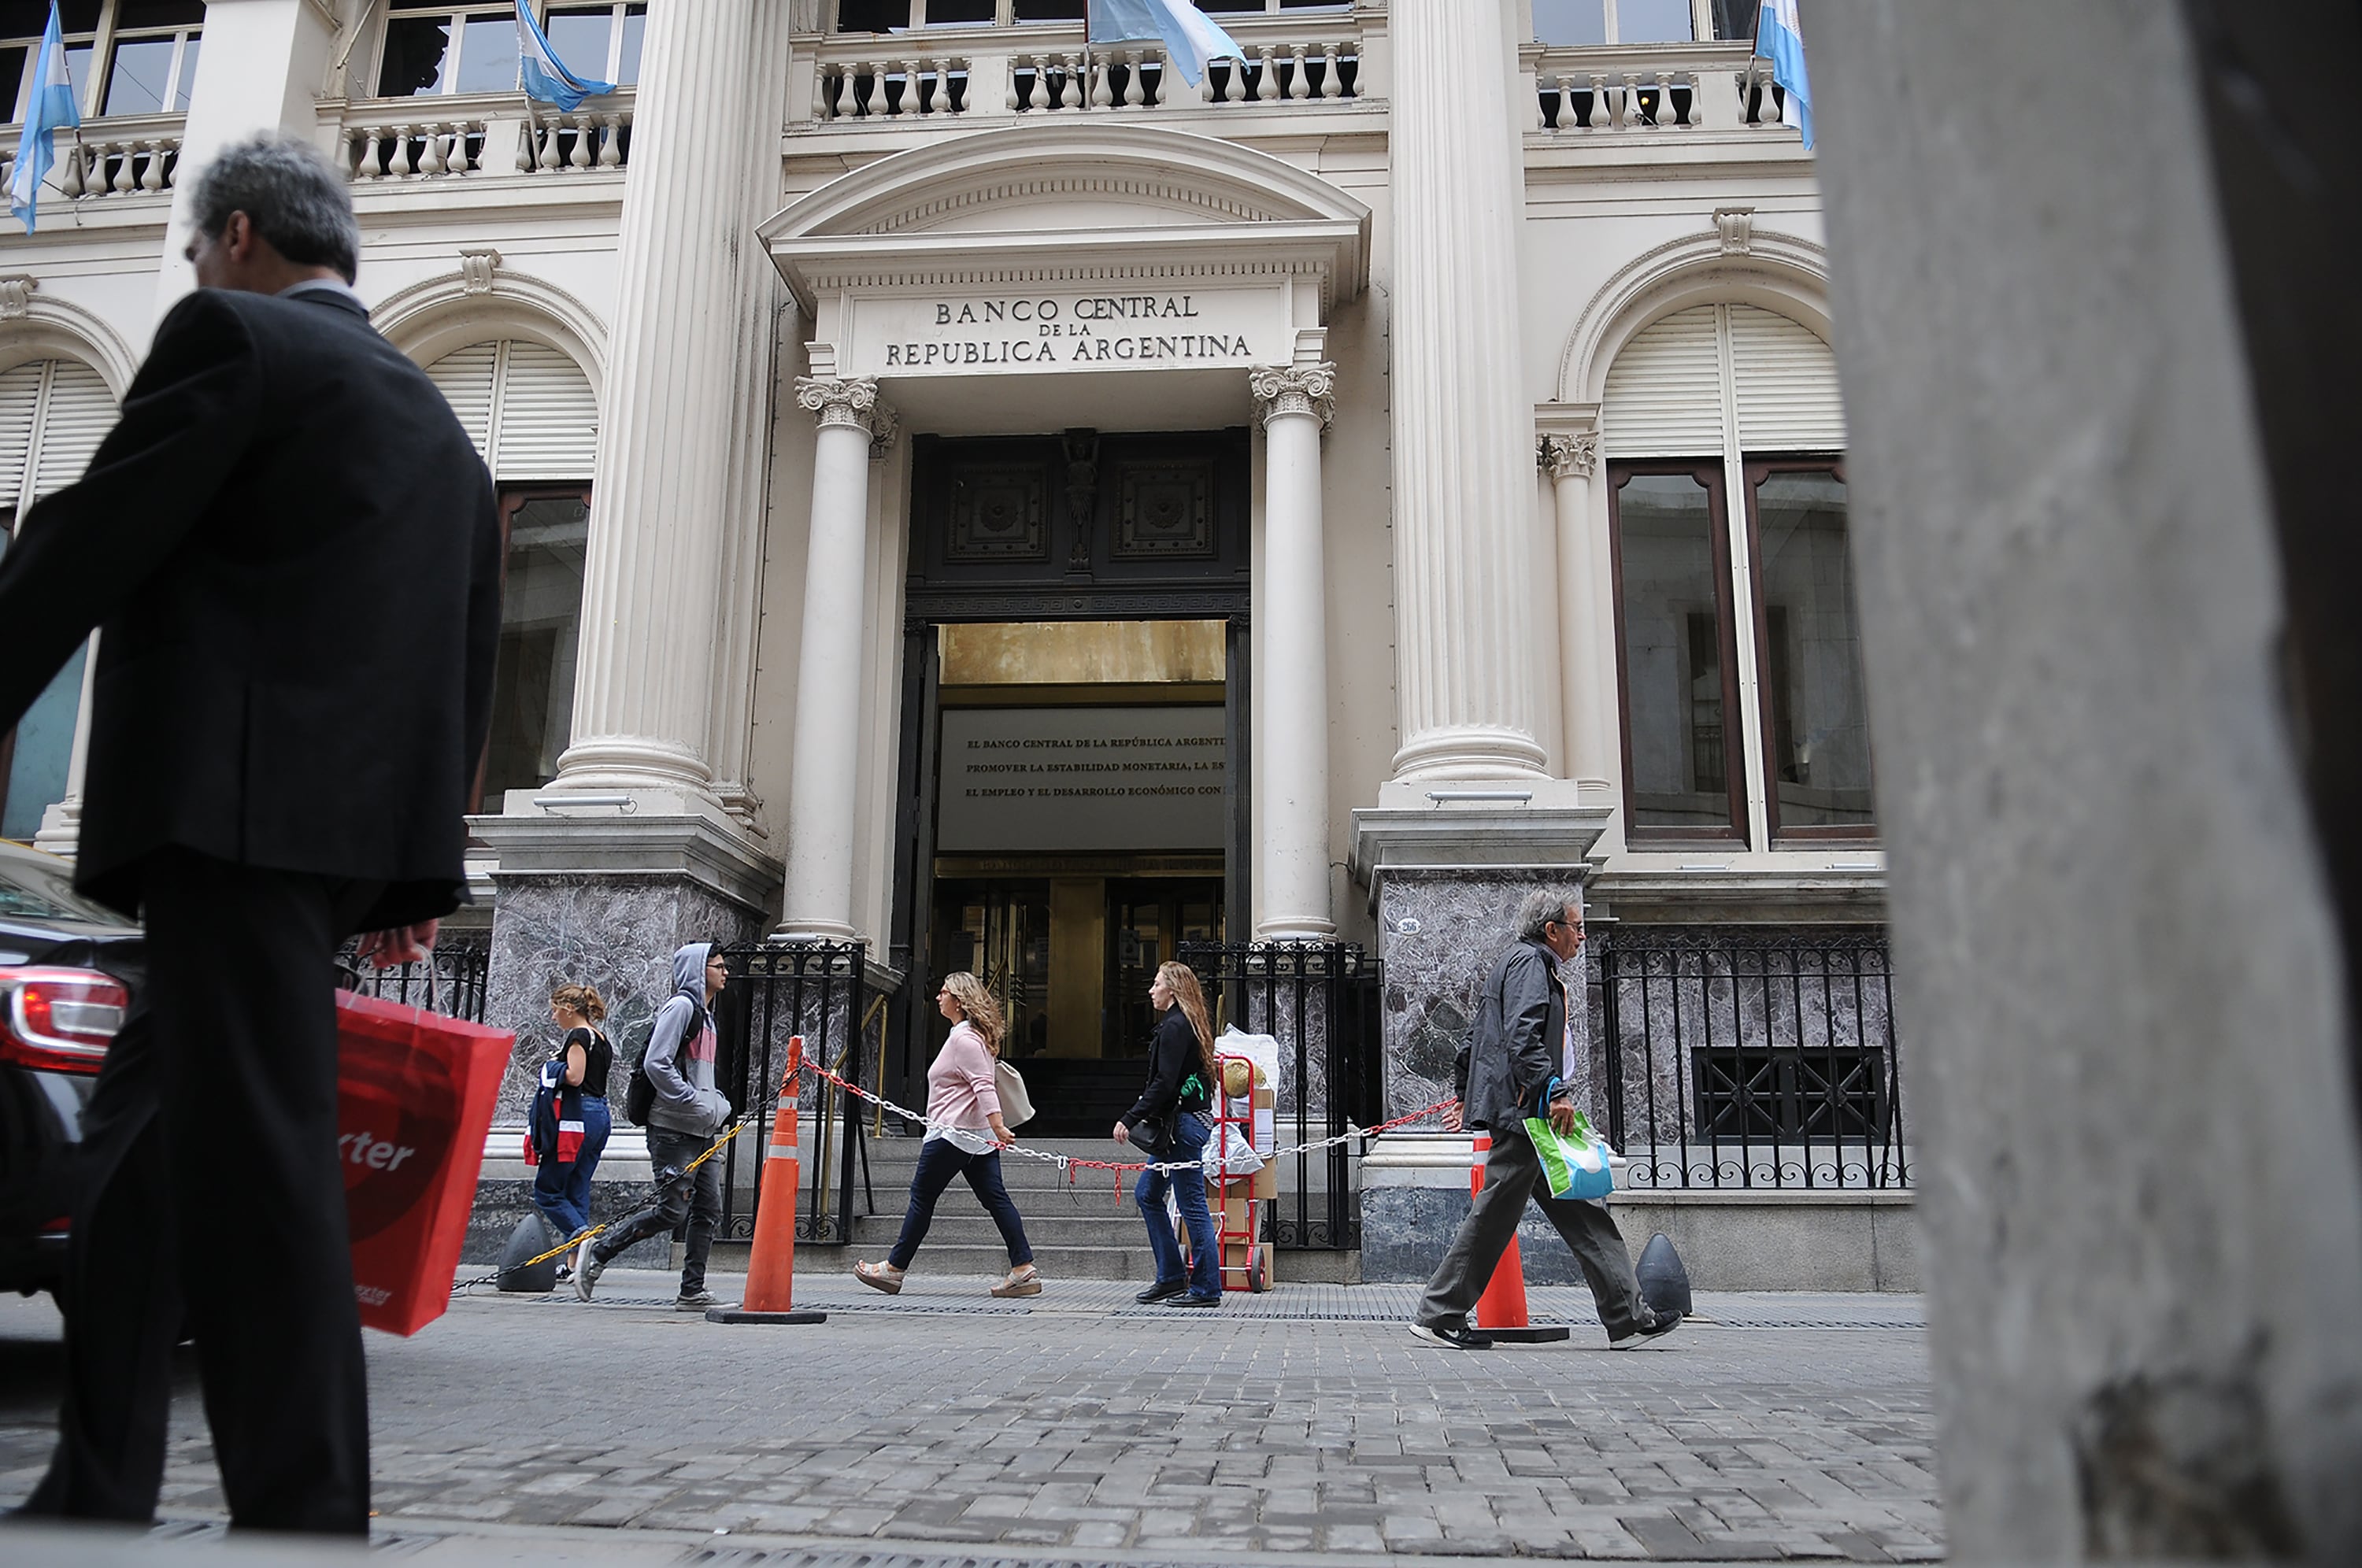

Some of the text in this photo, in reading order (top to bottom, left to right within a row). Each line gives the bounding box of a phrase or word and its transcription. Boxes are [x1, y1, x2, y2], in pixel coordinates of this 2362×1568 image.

[935, 296, 1199, 324] BANCO CENTRAL
[1038, 323, 1091, 337] DE LA
[886, 335, 1252, 366] REPUBLICA ARGENTINA
[967, 736, 1226, 749] EL BANCO CENTRAL DE LA REPÚBLICA ARGENTI
[966, 761, 1226, 773] PROMOVER LA ESTABILIDAD MONETARIA, LA ES
[982, 788, 1025, 797] EMPLEO
[1027, 788, 1035, 797] Y
[1038, 788, 1051, 797] EL
[1053, 787, 1125, 797] DESARROLLO
[1128, 784, 1195, 795] ECONÓMICO
[1198, 786, 1221, 795] CON
[1402, 921, 1416, 931] 266
